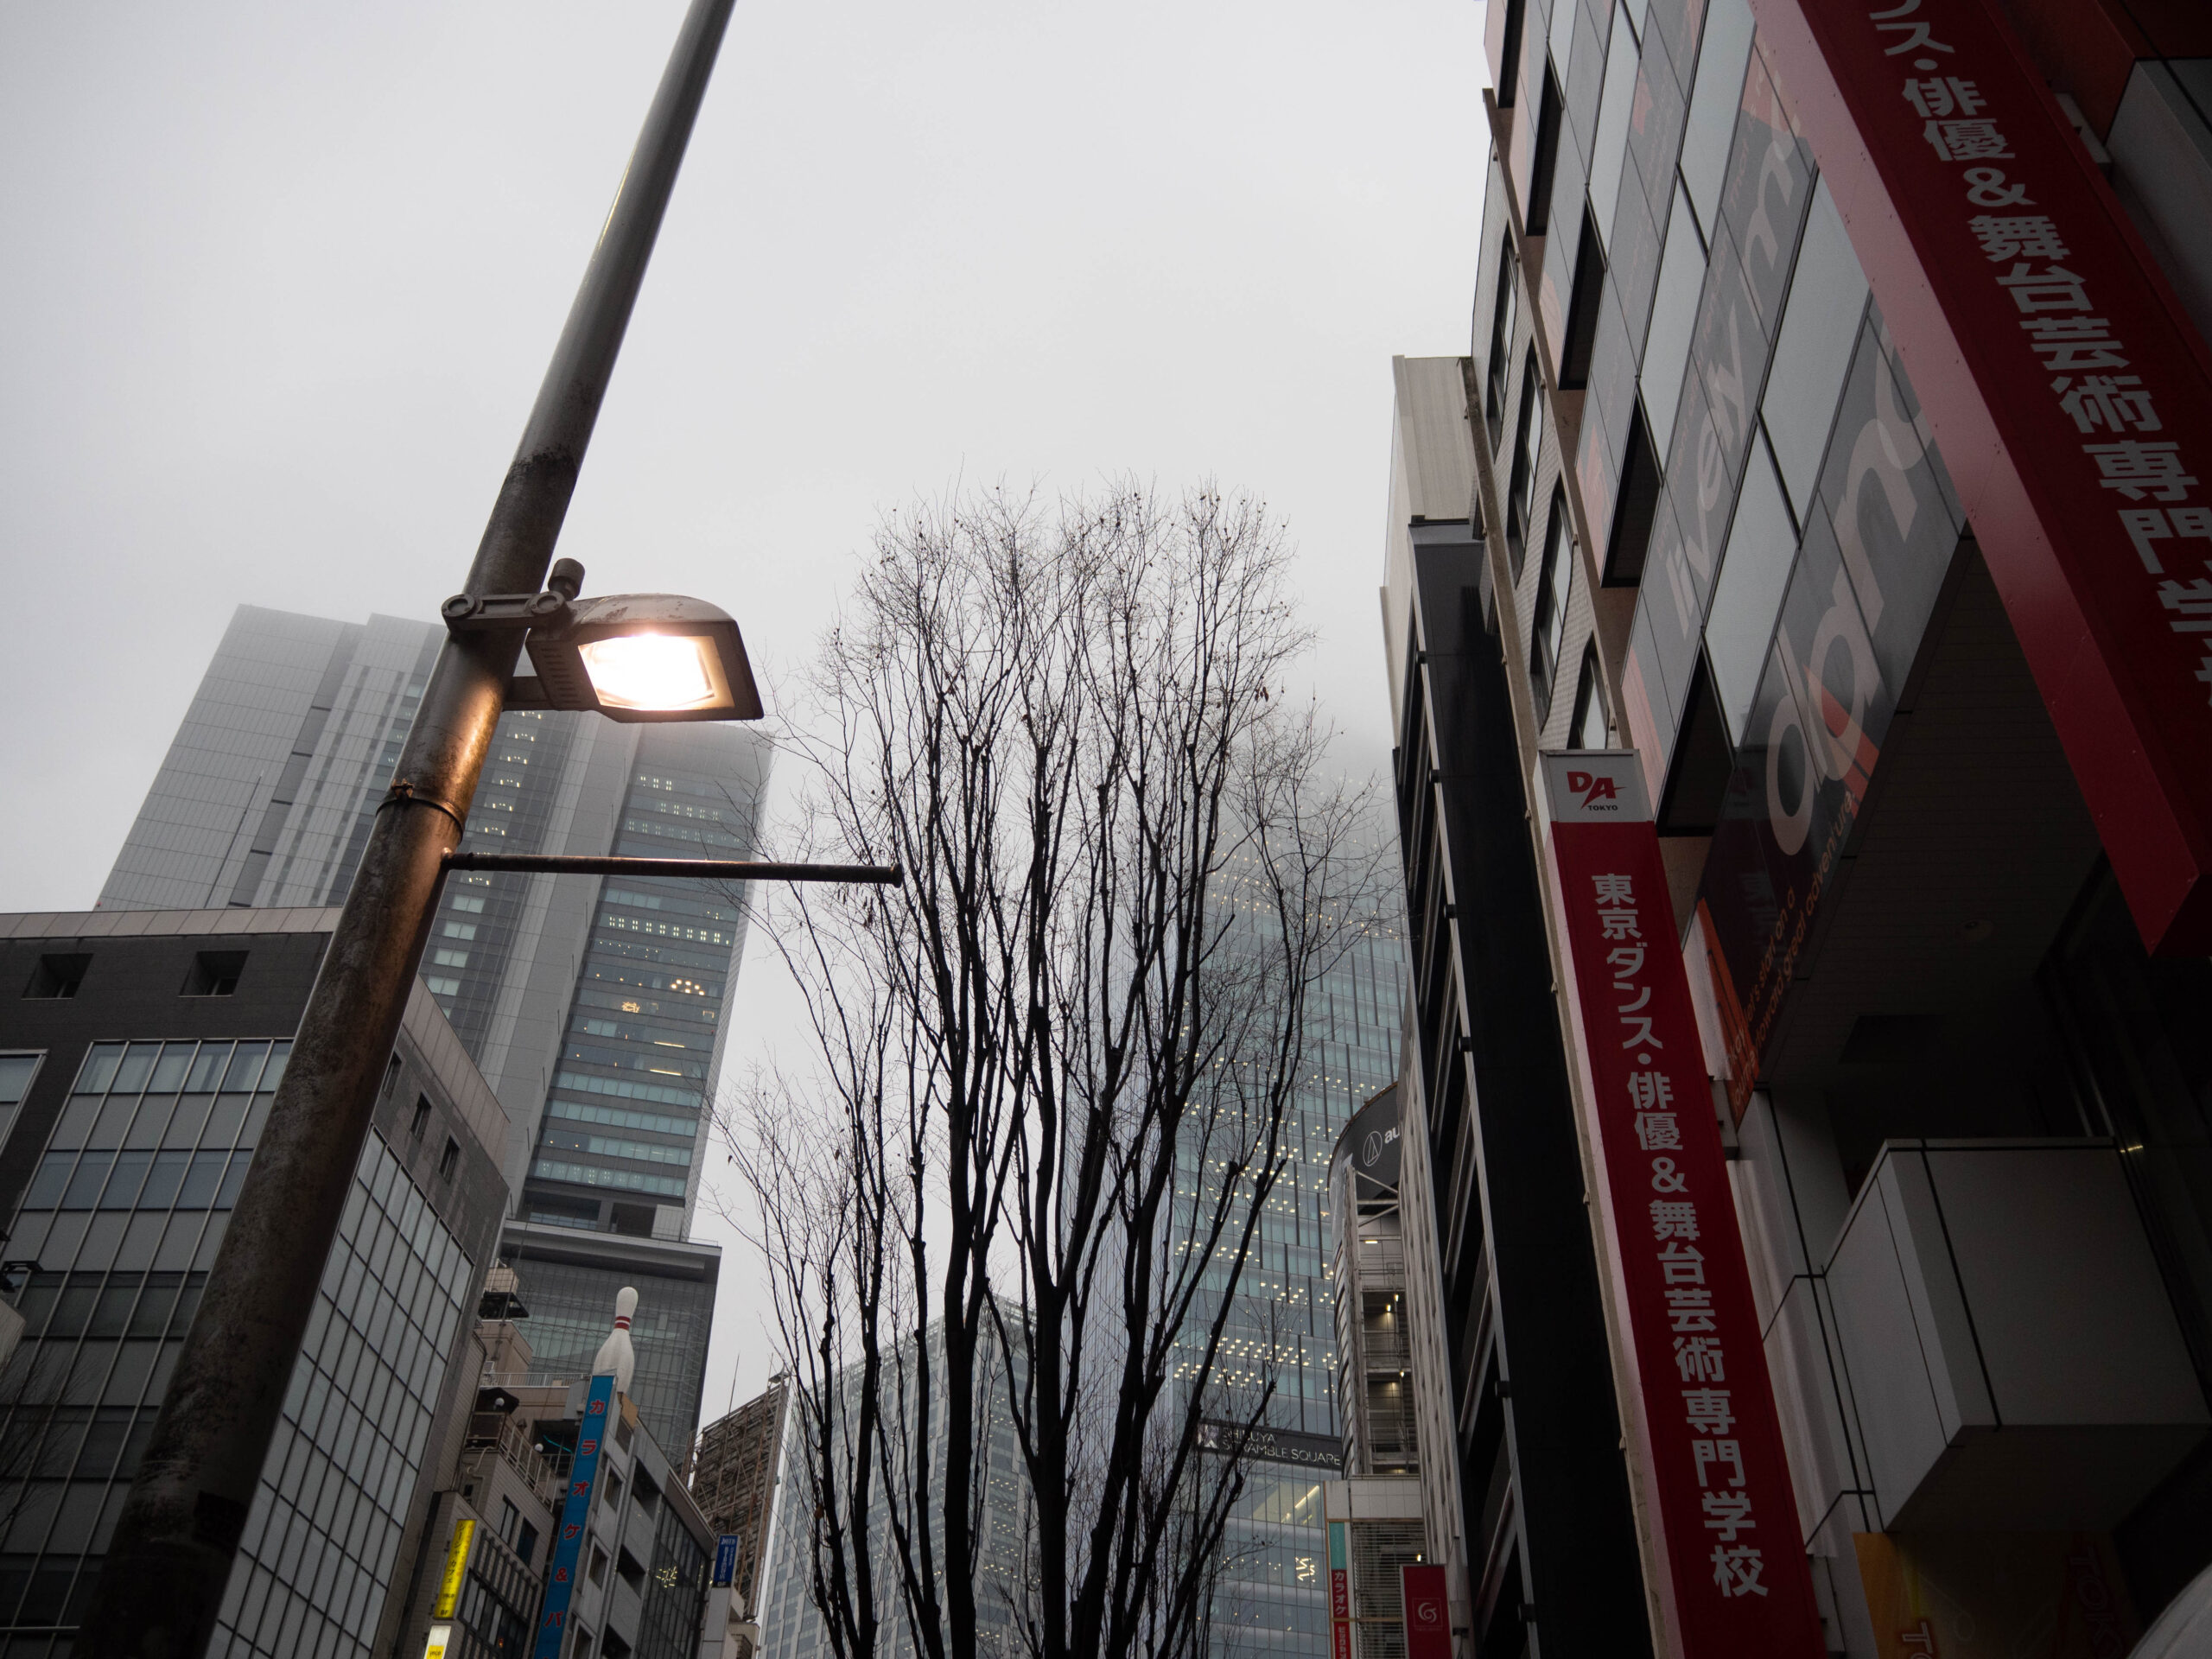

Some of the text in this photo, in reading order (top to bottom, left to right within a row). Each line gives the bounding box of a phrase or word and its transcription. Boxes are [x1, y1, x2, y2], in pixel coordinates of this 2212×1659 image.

[1567, 772, 1626, 809] DA
[1776, 907, 1789, 941] on
[1787, 885, 1796, 910] a
[1783, 909, 1806, 982] great
[1591, 873, 1769, 1598] 東京ダンス・俳優&舞台芸術専門学校
[1291, 1448, 1341, 1466] SQUARE
[526, 1400, 605, 1659] カラオケ&バ
[1334, 1571, 1347, 1616] カラオケ
